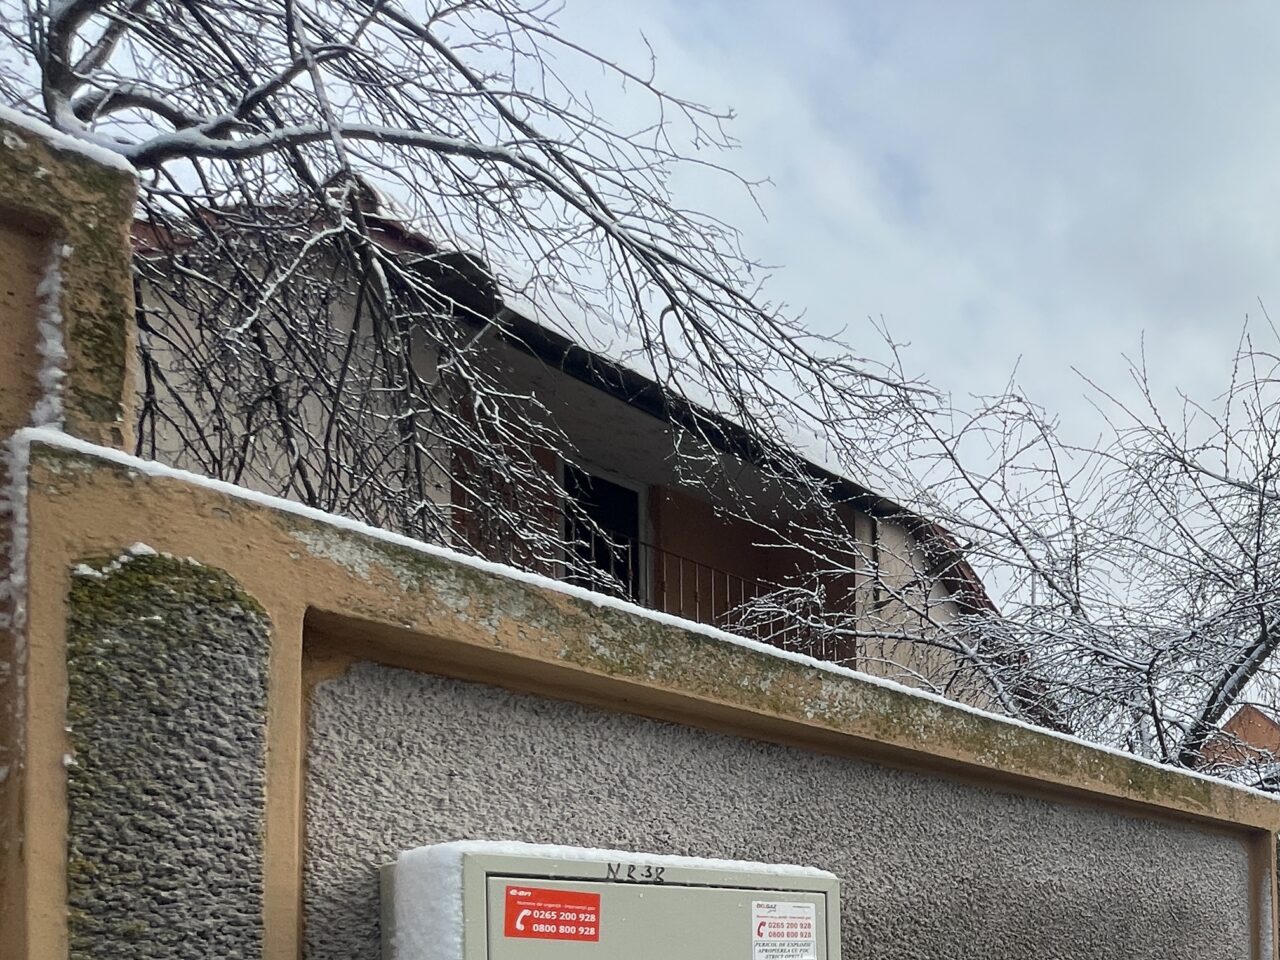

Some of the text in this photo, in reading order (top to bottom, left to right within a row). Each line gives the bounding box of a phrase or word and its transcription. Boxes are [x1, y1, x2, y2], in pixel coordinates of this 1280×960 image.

[533, 910, 596, 922] 0265 200 928
[532, 924, 596, 936] 0800 800 928
